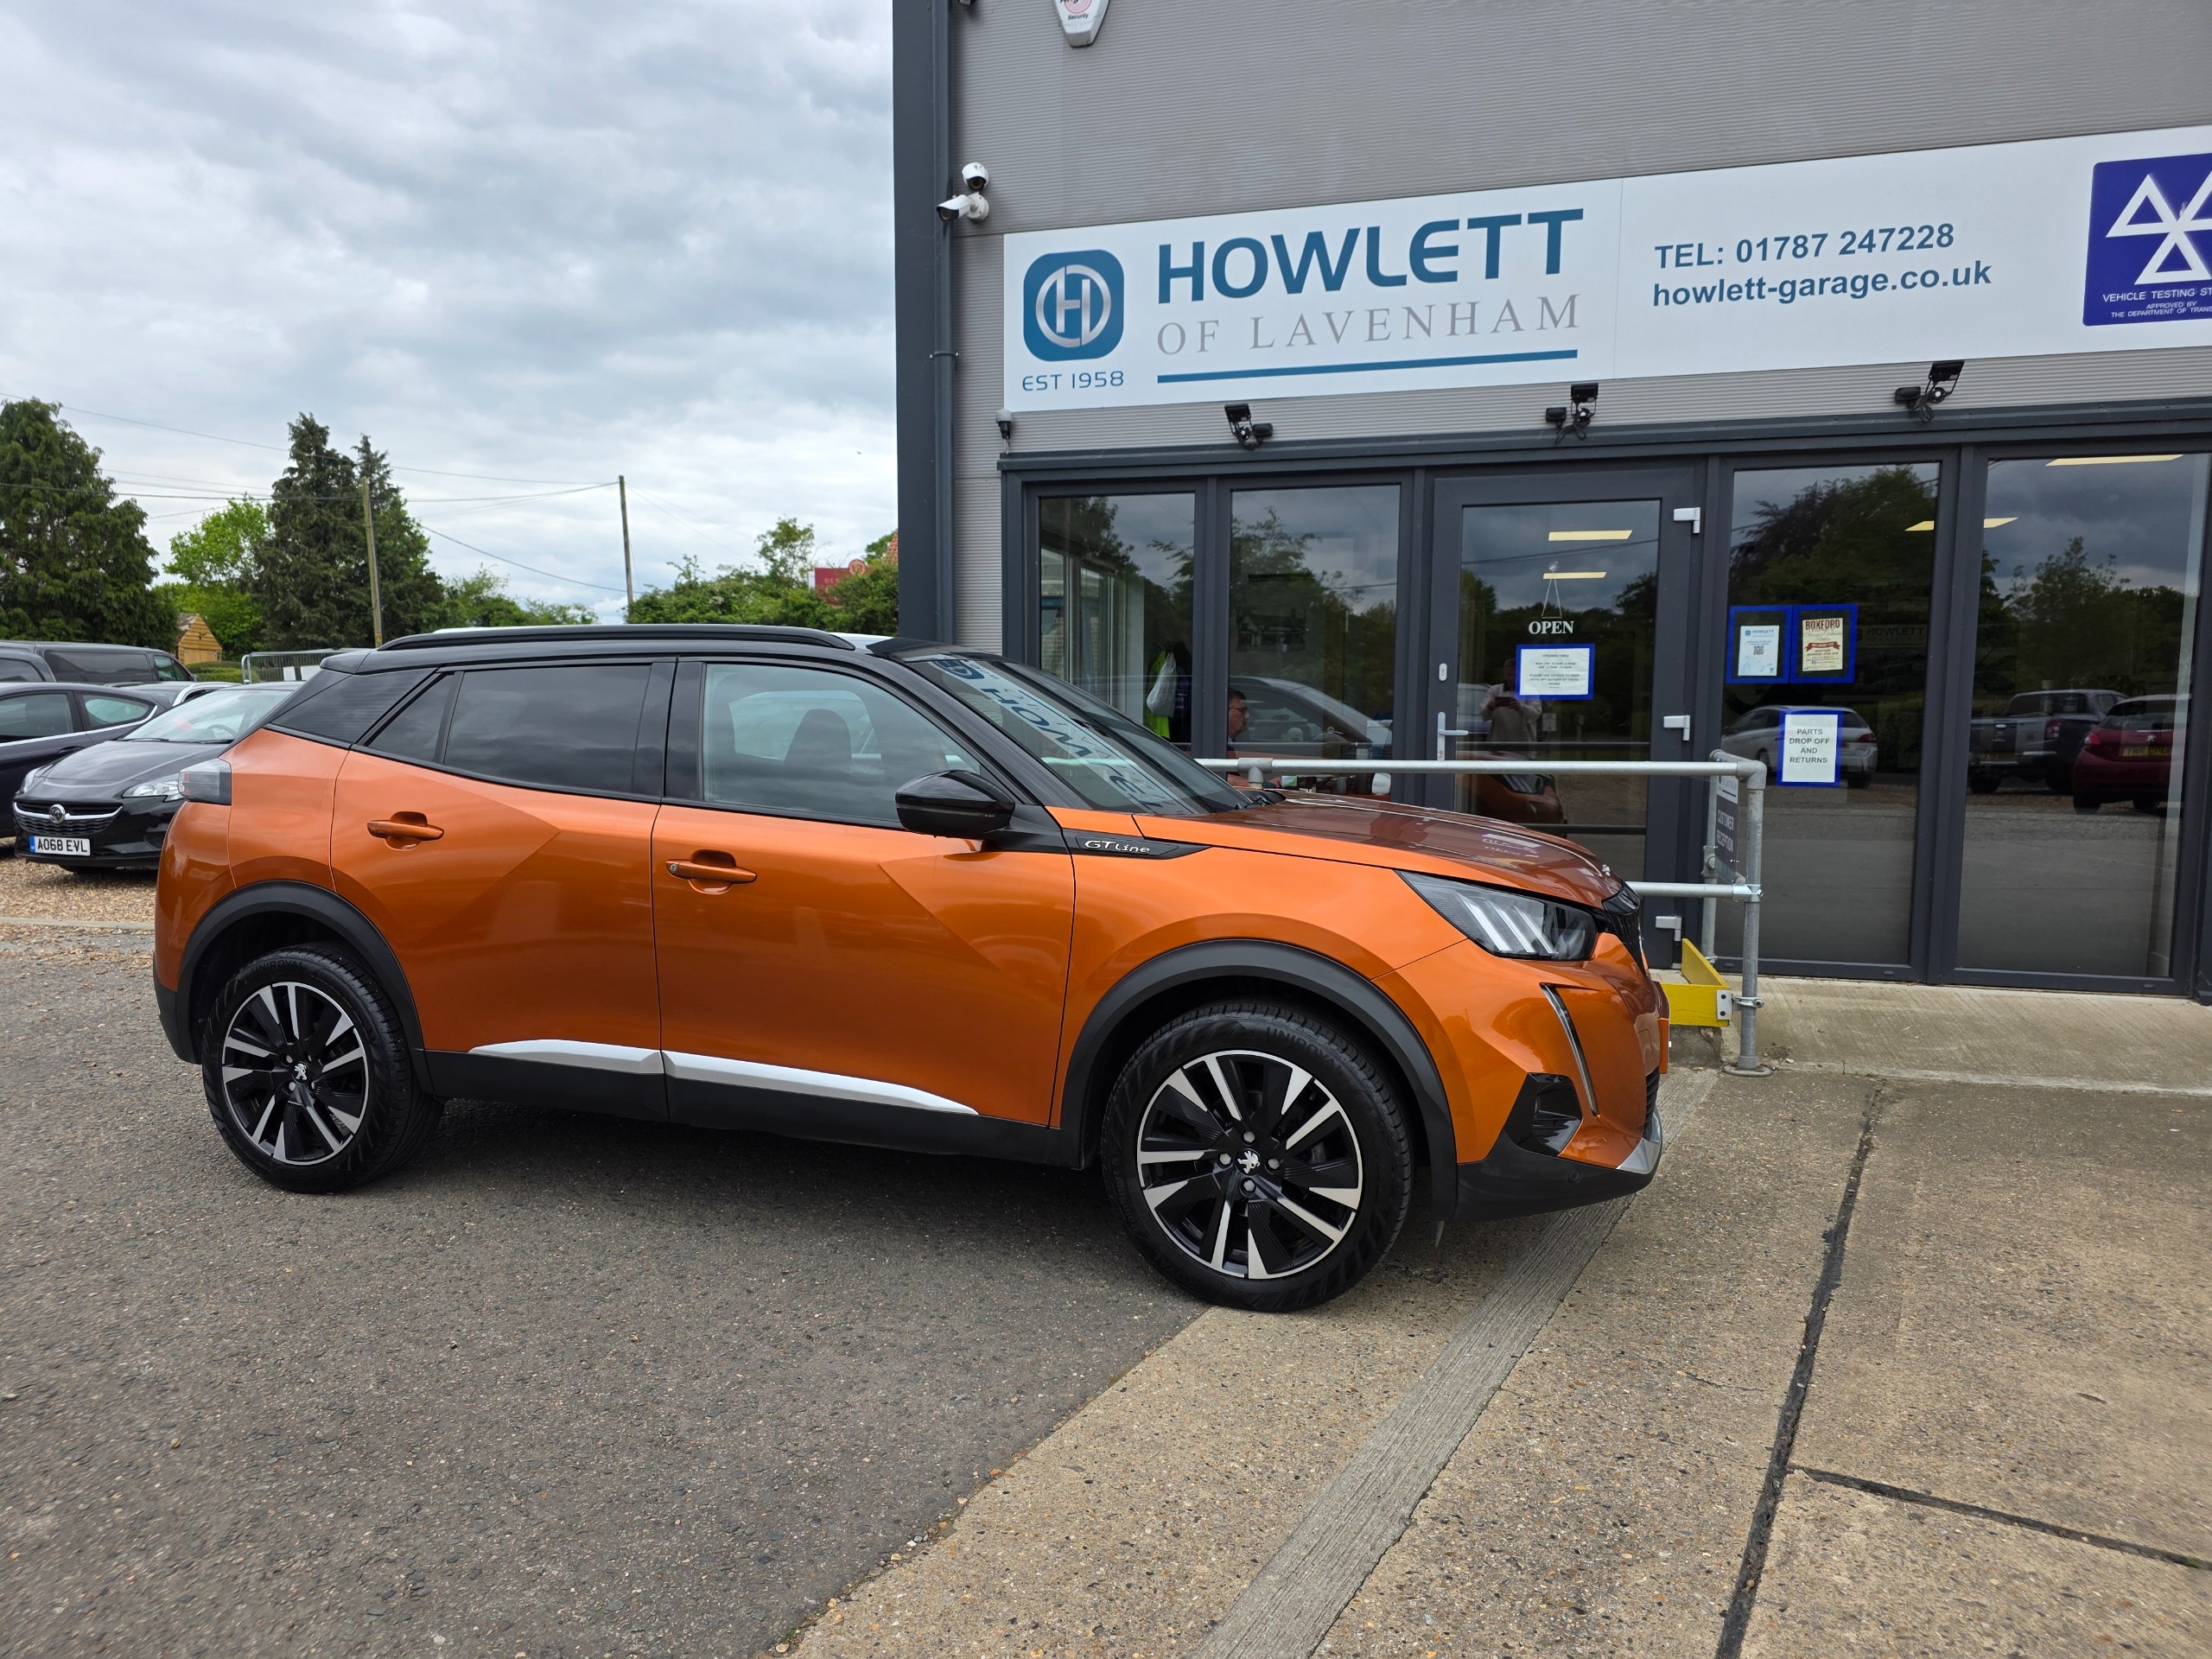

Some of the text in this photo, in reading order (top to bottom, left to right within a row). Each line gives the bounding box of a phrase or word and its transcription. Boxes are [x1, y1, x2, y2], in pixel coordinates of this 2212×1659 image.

[1654, 223, 1955, 269] TEL: 01787 247228
[1158, 207, 1585, 304] HOWLETT
[1653, 260, 1993, 307] howlett-garage.co.uk
[2102, 291, 2147, 302] VEHICLE
[2151, 288, 2196, 299] TESTING
[2127, 308, 2174, 317] DEPARTMENT
[2145, 302, 2183, 310] APPROVED
[1157, 294, 1581, 355] OF LAVENHAM
[1022, 371, 1124, 391] EST 1958
[1528, 620, 1575, 635] OPEN
[66, 840, 88, 853] EVL
[251, 959, 304, 976] UNIROYAL
